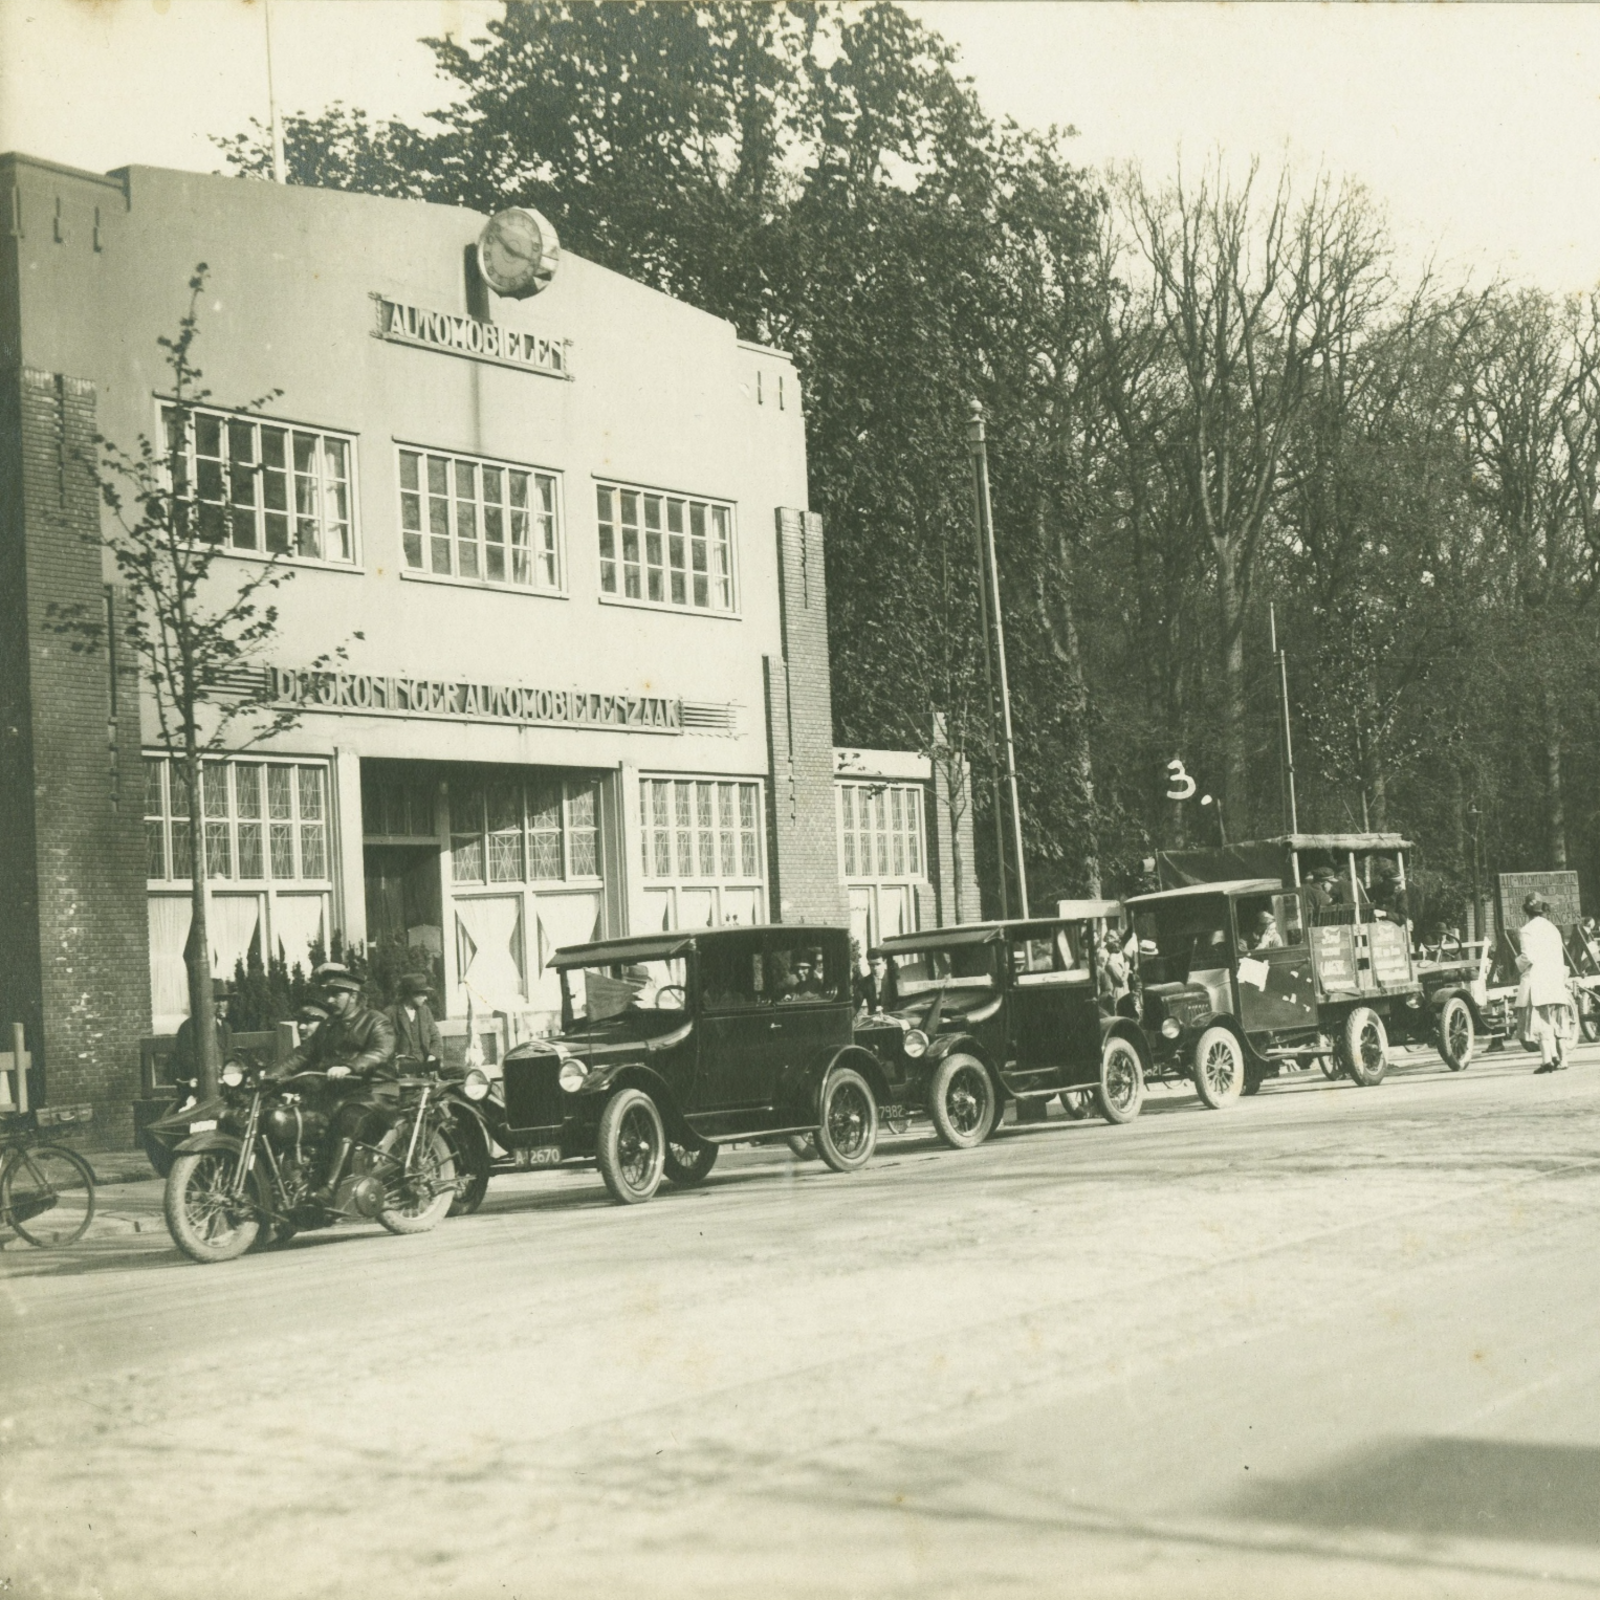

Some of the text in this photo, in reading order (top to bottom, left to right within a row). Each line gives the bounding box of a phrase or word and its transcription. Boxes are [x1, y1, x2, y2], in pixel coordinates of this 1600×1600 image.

[389, 303, 566, 371] AUTOMOBIELEN
[318, 671, 460, 714] GRONINGER
[465, 683, 681, 728] AUTOMOBIELENZAAK
[530, 1148, 560, 1164] 2670
